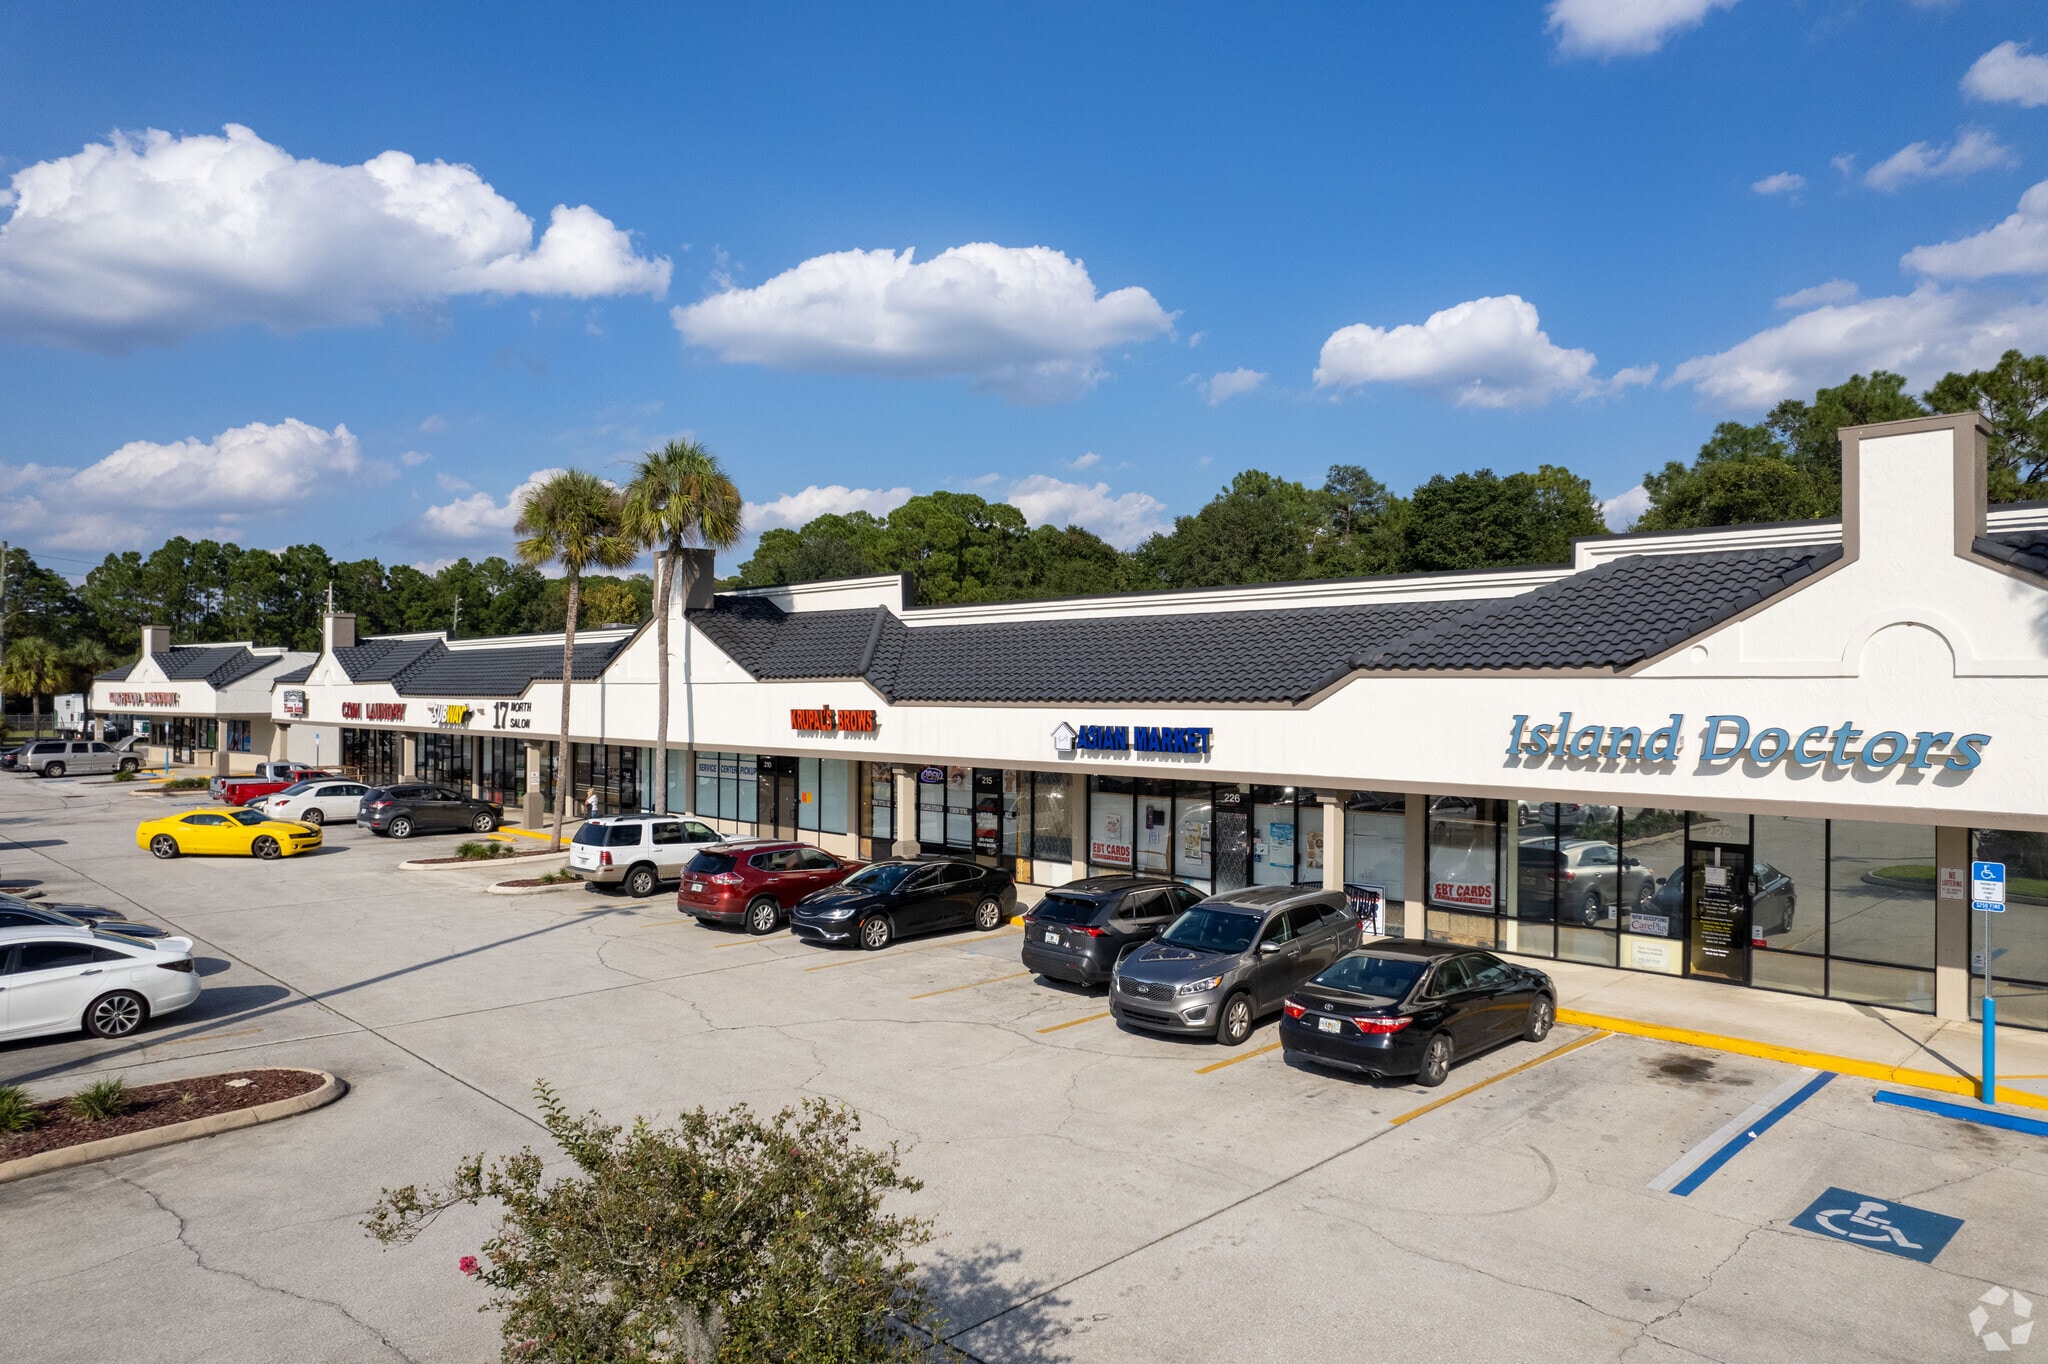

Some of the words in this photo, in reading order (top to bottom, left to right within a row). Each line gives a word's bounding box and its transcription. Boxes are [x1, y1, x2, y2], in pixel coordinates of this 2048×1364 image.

[366, 703, 405, 720] LAUNDRY
[431, 704, 468, 724] SUBWAY
[493, 702, 509, 729] 17
[510, 702, 532, 712] NORTH
[510, 718, 531, 729] SALON
[790, 704, 834, 731] KRUPAL'S
[837, 710, 874, 732] BROWS
[1077, 725, 1128, 750] ASIAN
[1134, 727, 1213, 753] MARKET
[1505, 712, 1683, 761] Island
[1699, 714, 1991, 771] Doctors
[698, 763, 717, 773] SERVICE
[721, 764, 737, 774] CENTER
[740, 766, 757, 775] PICKUP
[981, 776, 993, 785] 215
[1224, 793, 1241, 803] 226
[1706, 826, 1731, 837] 228
[1092, 842, 1105, 853] EBT
[1106, 844, 1130, 857] CARDS
[1948, 871, 1956, 879] NO
[1942, 880, 1962, 888] LOITERING
[1435, 883, 1454, 896] EBT
[1456, 885, 1492, 898] CARDS
[1643, 915, 1668, 924] ACCEPTING
[1631, 920, 1668, 932] CarePlus
